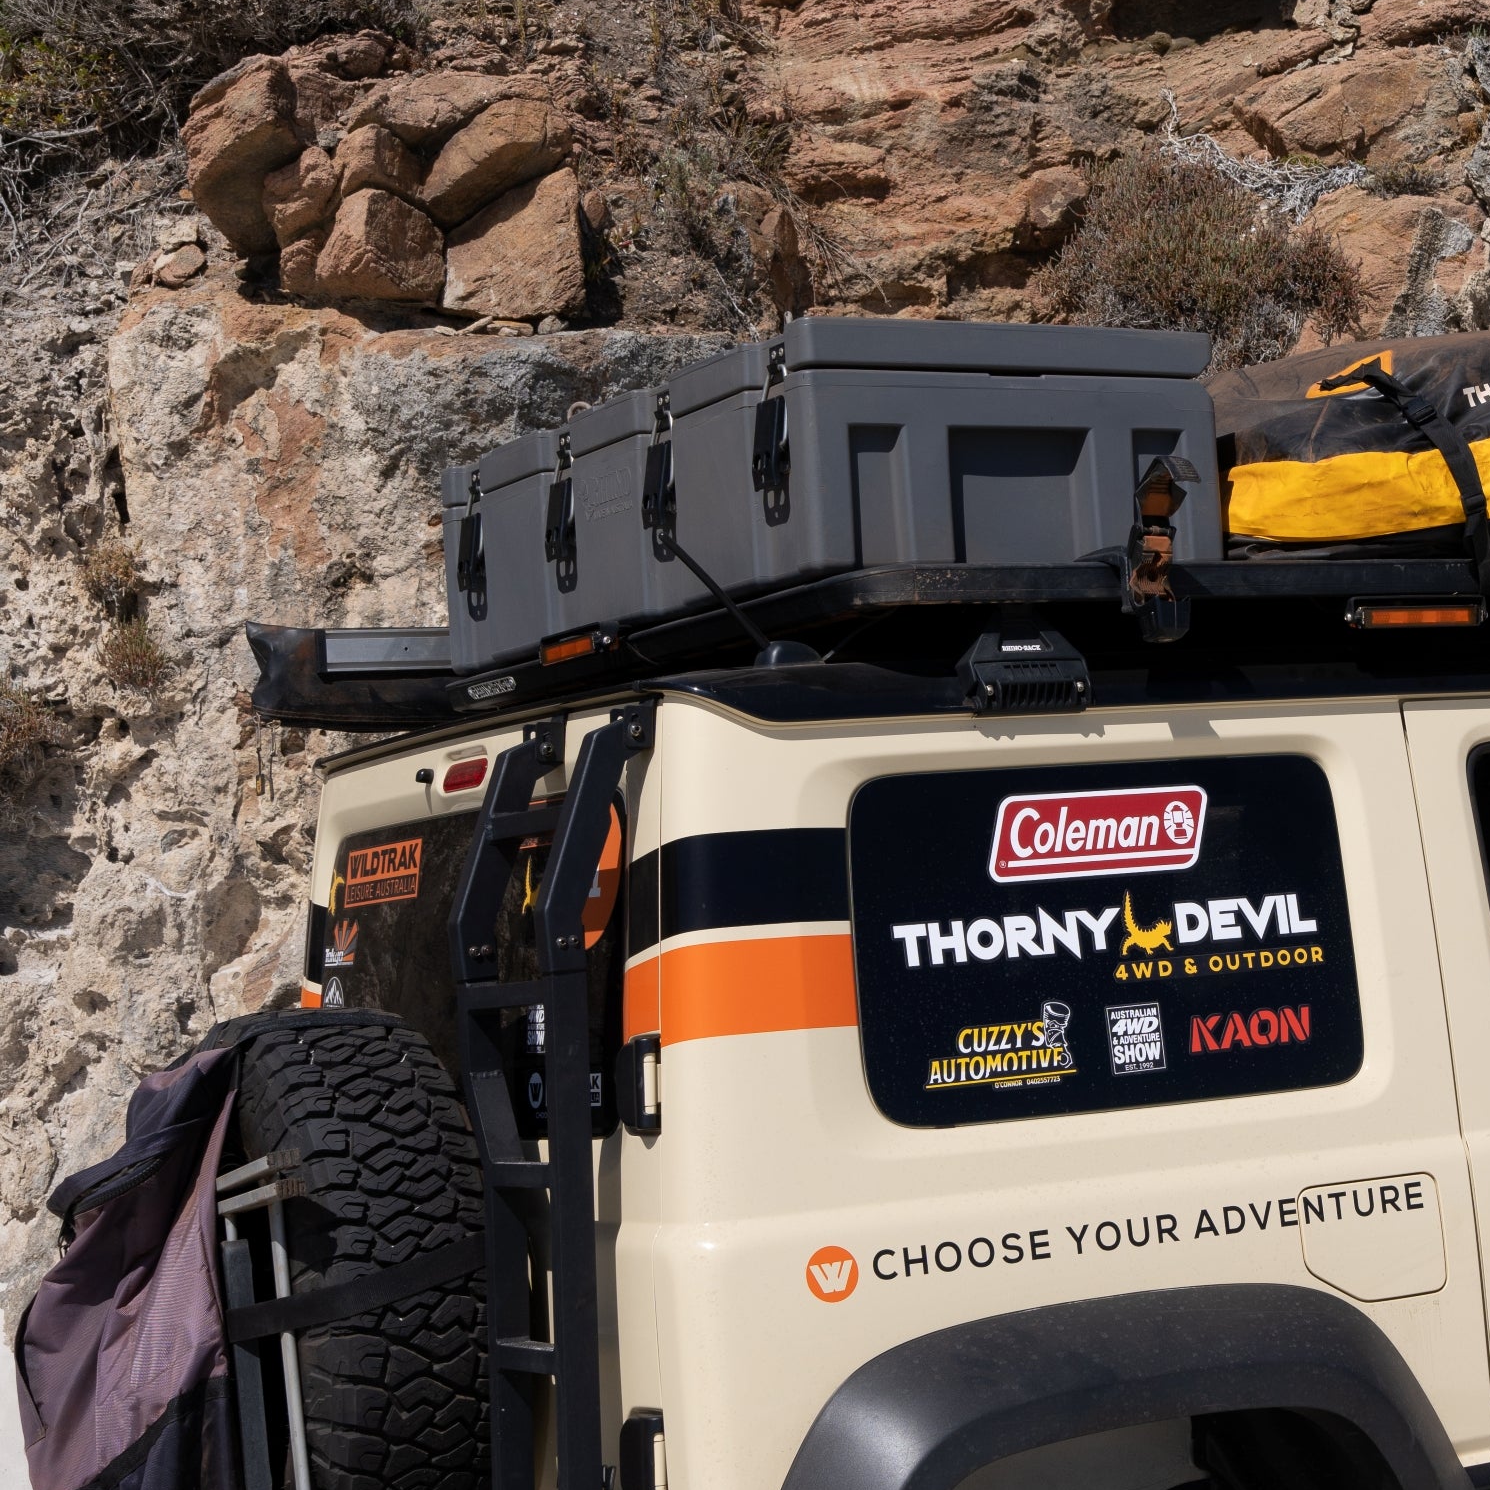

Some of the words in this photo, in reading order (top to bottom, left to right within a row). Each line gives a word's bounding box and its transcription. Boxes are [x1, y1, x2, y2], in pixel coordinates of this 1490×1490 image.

[1010, 806, 1160, 858] Coleman
[350, 842, 419, 880] WILDTRAK
[347, 882, 374, 903] LEISURE
[376, 876, 417, 899] AUSTRALIA
[892, 906, 1121, 967] THORNY
[1174, 893, 1317, 944] DEVIL
[1115, 960, 1173, 981] 4WD
[1184, 958, 1198, 974] &
[1208, 946, 1324, 972] OUTDOOR
[1110, 1007, 1157, 1020] AUSTRALIAN
[1112, 1016, 1159, 1036] 4WD
[1190, 1005, 1310, 1054] KAON
[958, 1021, 1046, 1054] CUZZY'S
[1112, 1036, 1118, 1045] &
[1120, 1032, 1160, 1045] ADVENTURE
[1113, 1042, 1160, 1065] SHOW
[1139, 1061, 1154, 1069] 1992
[872, 1228, 1052, 1281] CHOOSE
[1065, 1214, 1179, 1255] YOUR
[1194, 1181, 1425, 1239] ADVENTURE
